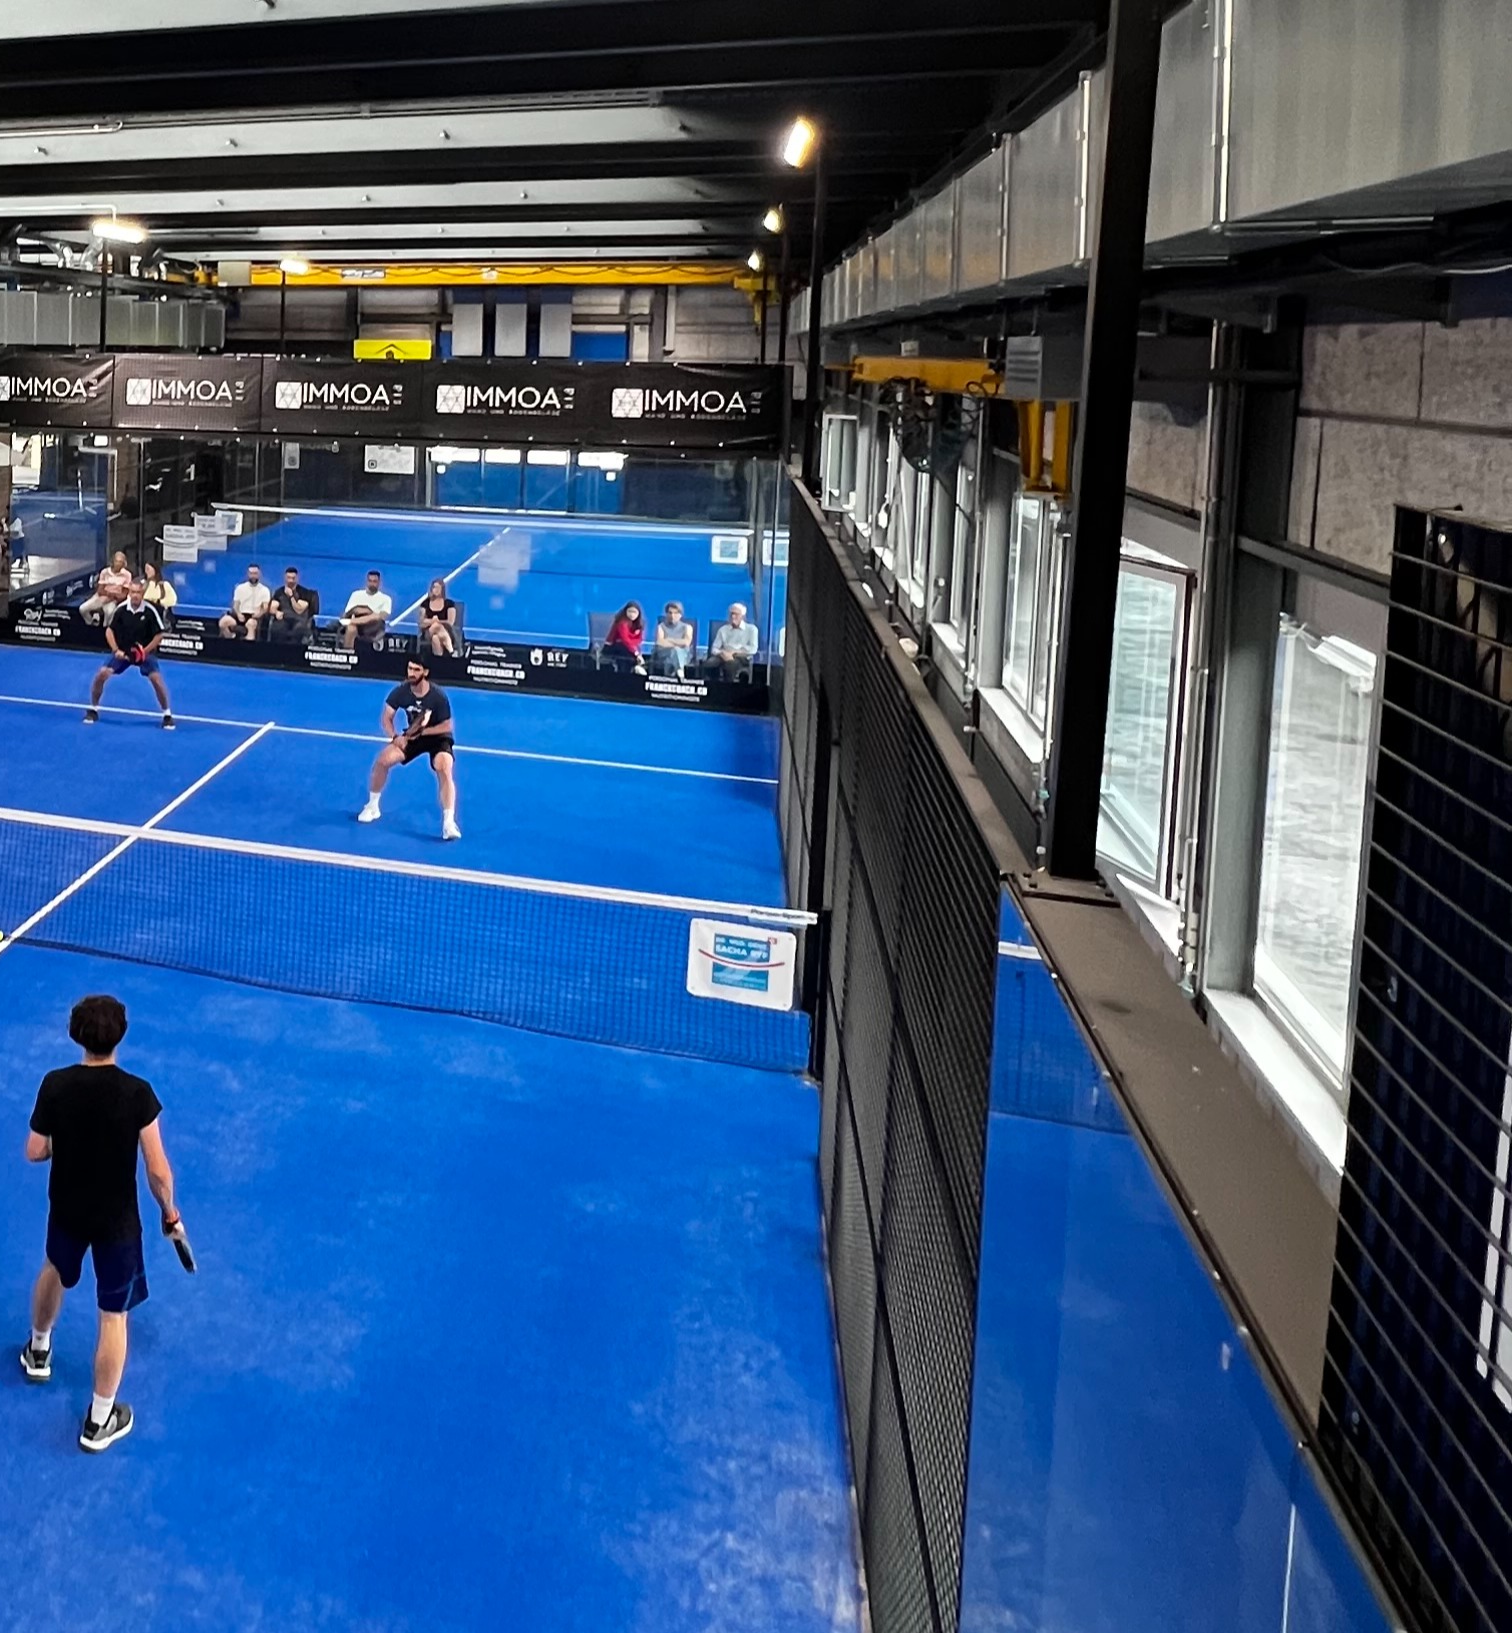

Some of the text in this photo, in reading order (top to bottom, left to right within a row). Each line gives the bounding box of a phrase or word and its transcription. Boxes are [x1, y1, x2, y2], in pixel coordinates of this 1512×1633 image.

[11, 376, 88, 398] IMMOA
[152, 379, 233, 401] IMMOA
[303, 382, 390, 405] IMMOA
[466, 385, 561, 409] IMMOA
[645, 389, 747, 413] IMMOA
